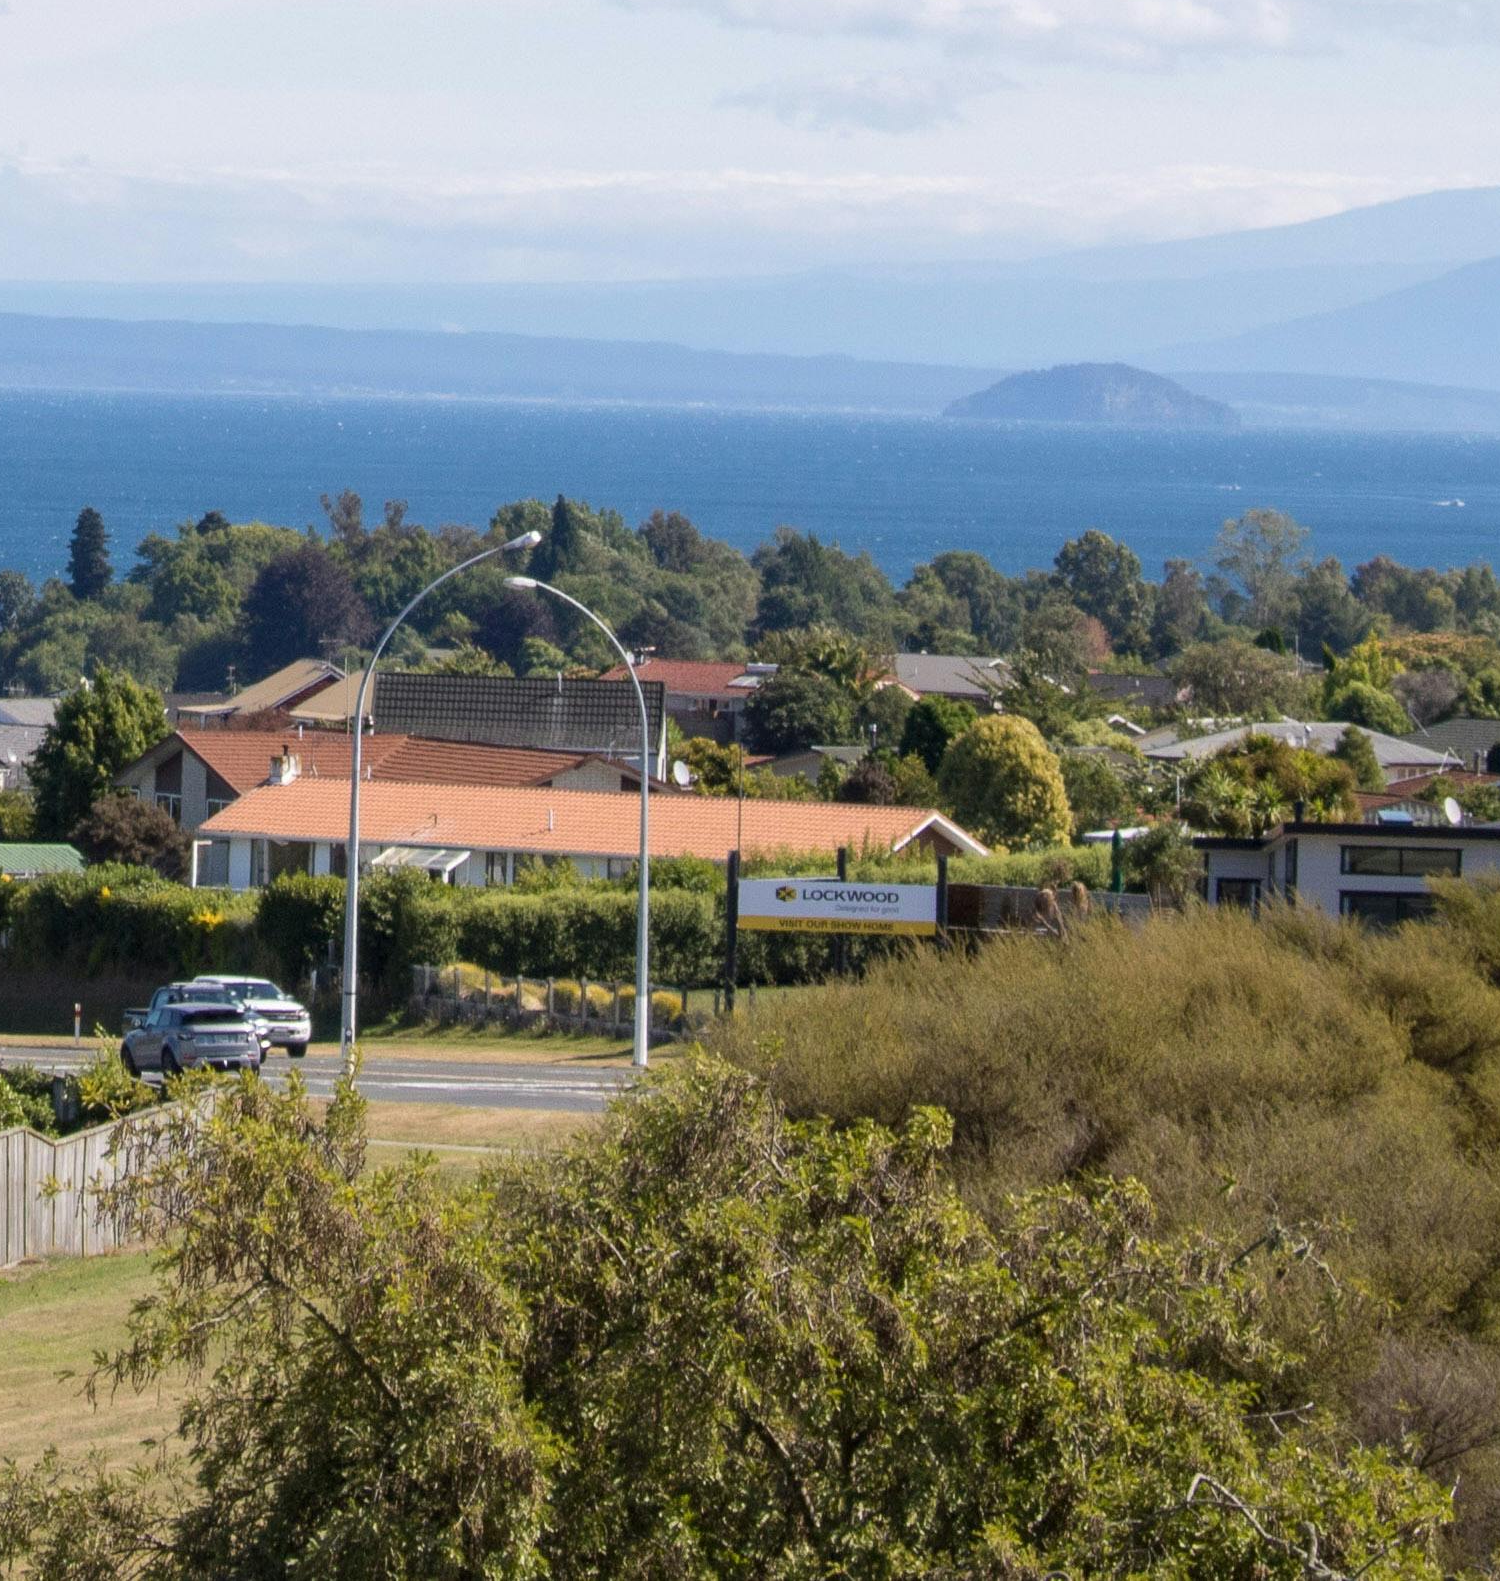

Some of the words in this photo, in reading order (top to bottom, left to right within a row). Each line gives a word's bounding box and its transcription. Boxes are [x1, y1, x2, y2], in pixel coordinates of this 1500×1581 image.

[802, 889, 899, 903] LOCKWOOD
[779, 919, 803, 928] VISIT
[807, 920, 828, 929] OUR
[831, 920, 861, 930] SHOW
[863, 921, 894, 930] HOME
